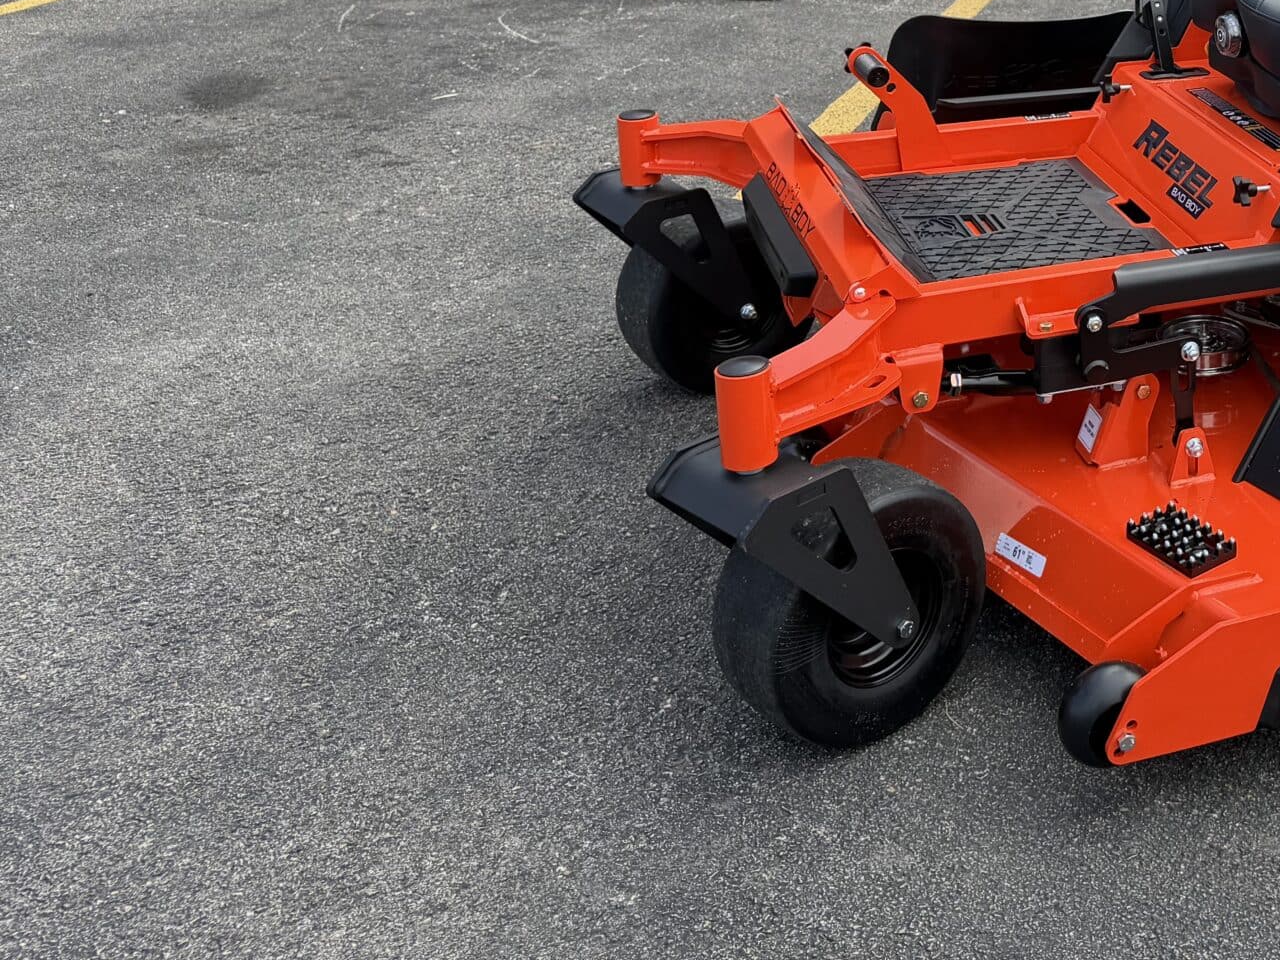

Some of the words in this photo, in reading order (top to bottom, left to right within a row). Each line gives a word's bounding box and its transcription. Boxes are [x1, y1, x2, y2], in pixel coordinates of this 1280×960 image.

[766, 161, 787, 197] BAD
[791, 202, 816, 241] BOY
[1132, 118, 1218, 209] REBEL
[1170, 186, 1187, 203] BAD
[1184, 198, 1202, 215] BOY
